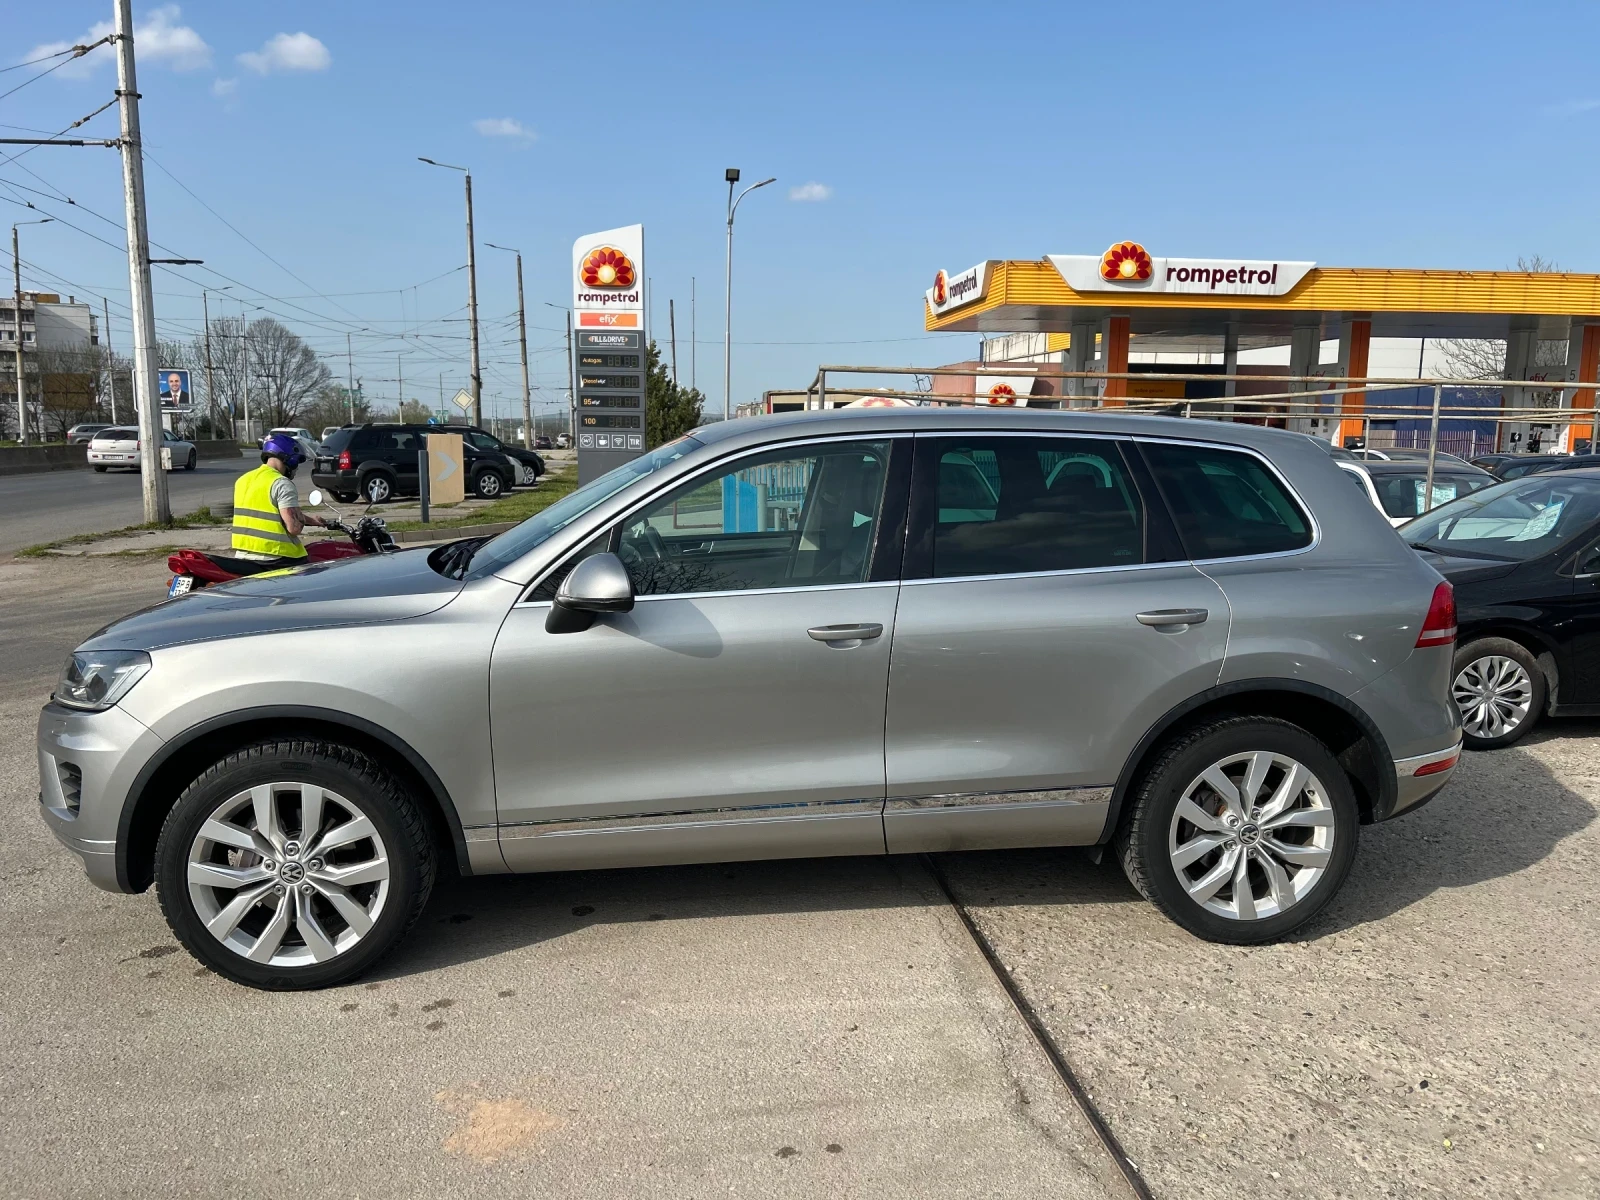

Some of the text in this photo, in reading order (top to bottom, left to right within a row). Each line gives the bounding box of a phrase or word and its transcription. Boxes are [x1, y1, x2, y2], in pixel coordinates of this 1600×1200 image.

[1166, 264, 1278, 289] rompetrol
[949, 268, 977, 300] rompetrol
[578, 291, 639, 305] rompetrol
[599, 314, 619, 325] efix
[591, 335, 625, 343] FILL&DRIVE
[1569, 369, 1577, 381] 5
[584, 417, 597, 425] 100
[629, 438, 640, 446] TIR
